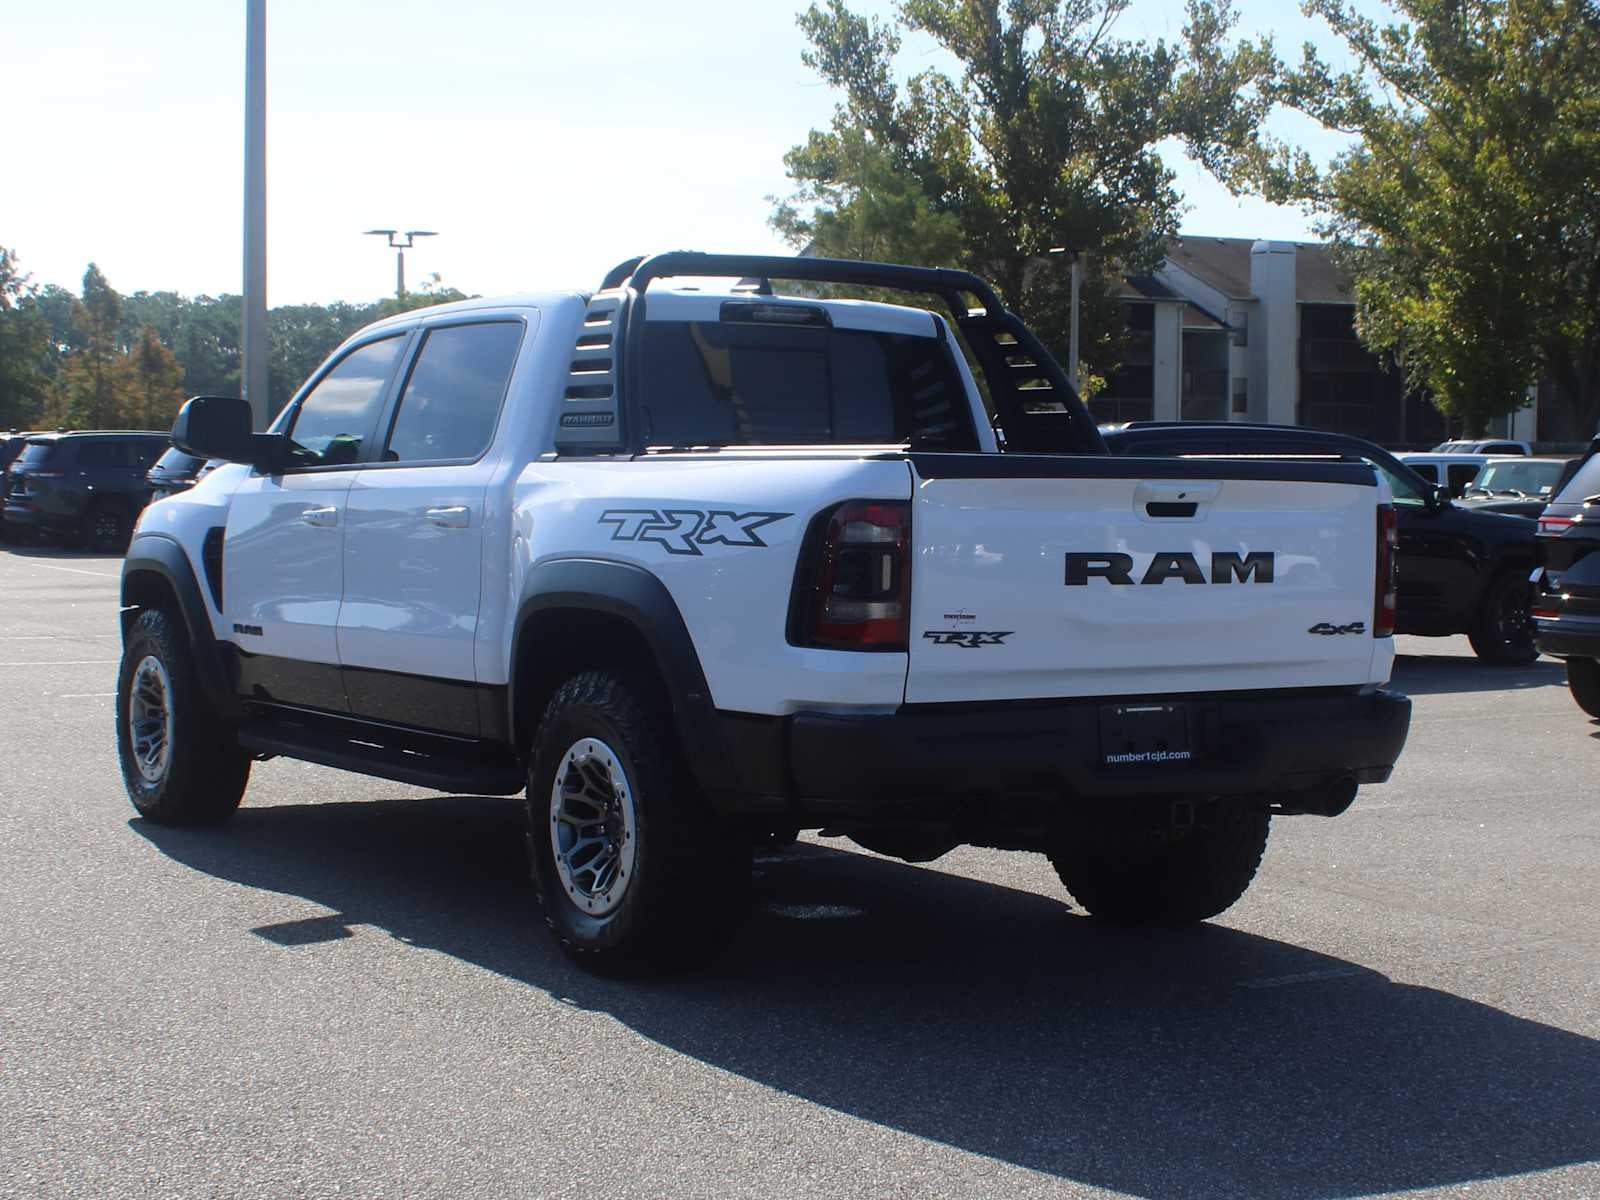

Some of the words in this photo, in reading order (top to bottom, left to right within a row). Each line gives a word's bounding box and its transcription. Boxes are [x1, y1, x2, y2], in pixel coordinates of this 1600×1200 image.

[598, 509, 796, 556] TRX
[1064, 551, 1275, 586] RAM
[922, 630, 1017, 648] TRX
[1106, 751, 1191, 763] number1cjd.com
